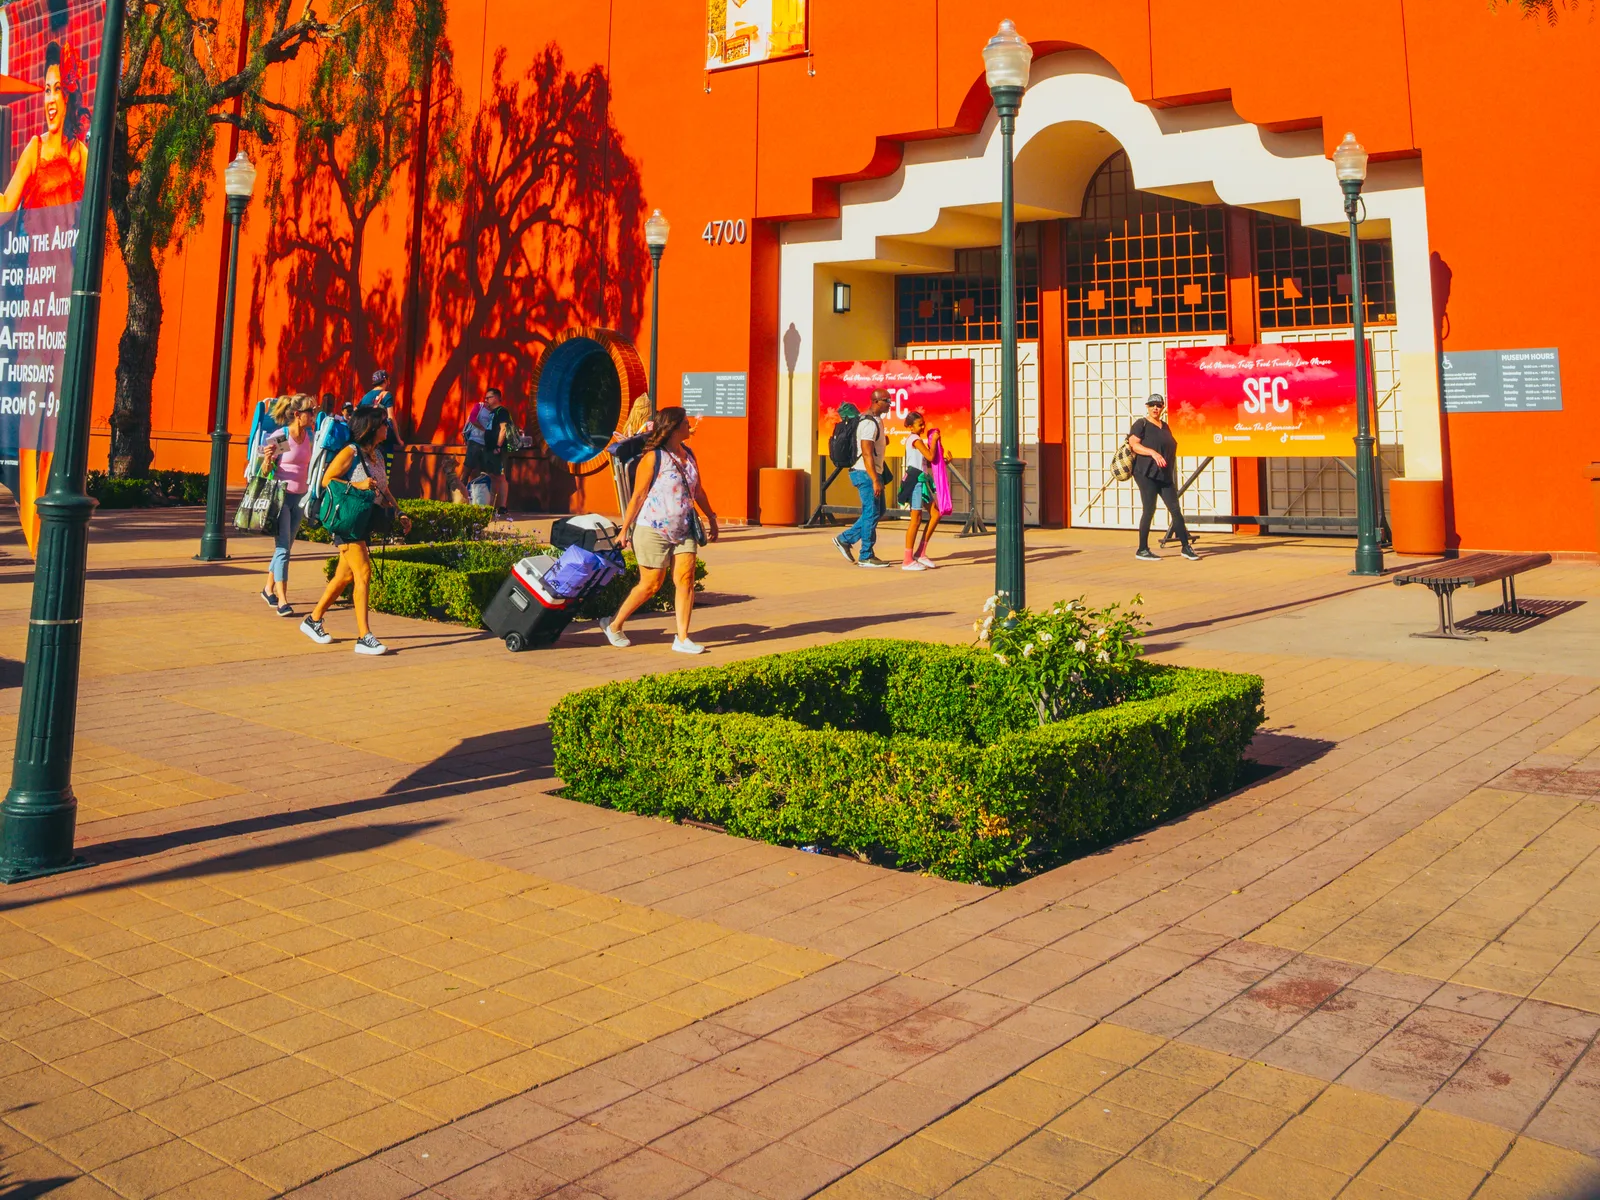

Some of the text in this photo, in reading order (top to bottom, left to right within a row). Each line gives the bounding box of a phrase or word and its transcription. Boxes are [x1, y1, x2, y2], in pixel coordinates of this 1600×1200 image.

[3, 231, 29, 255] JOIN
[32, 234, 50, 253] THE
[701, 219, 746, 244] 4700
[2, 266, 57, 286] FOR HAPPY
[0, 300, 30, 318] HOUR
[32, 299, 45, 317] AT
[0, 325, 35, 350] AFTER
[0, 357, 54, 383] THURSDAYS
[0, 396, 26, 415] ROM
[28, 390, 37, 416] 6
[46, 391, 55, 417] 9
[880, 388, 908, 420] FC
[1243, 376, 1289, 414] SFC
